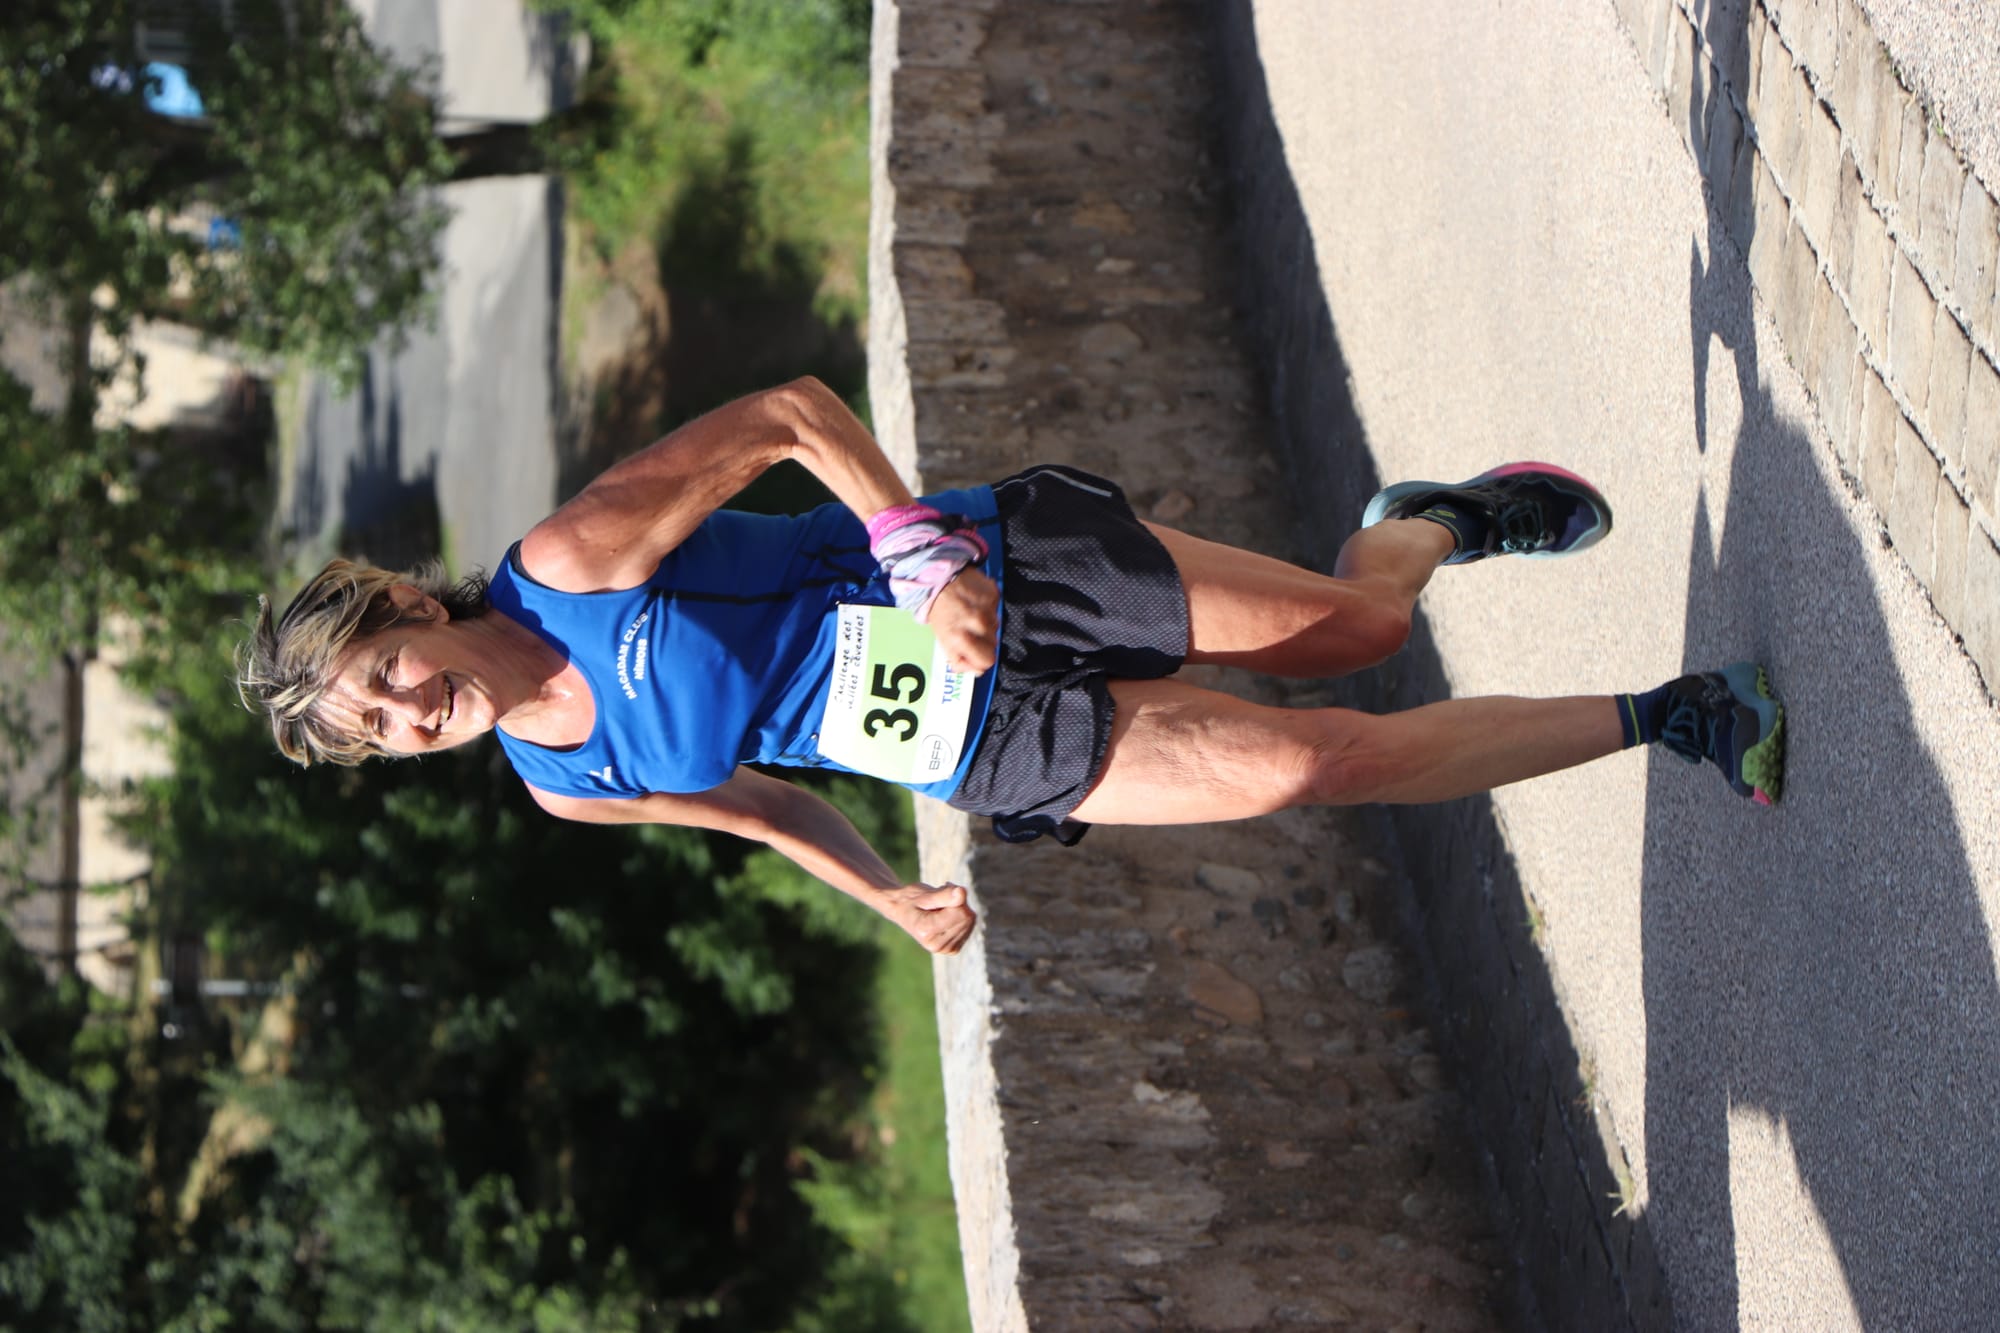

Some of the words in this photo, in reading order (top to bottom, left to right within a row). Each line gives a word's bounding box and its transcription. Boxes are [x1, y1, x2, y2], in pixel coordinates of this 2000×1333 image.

[843, 620, 852, 641] des
[616, 644, 638, 699] MACADAM
[941, 660, 955, 704] TUFF
[863, 662, 927, 743] 35
[928, 740, 942, 770] BFP
